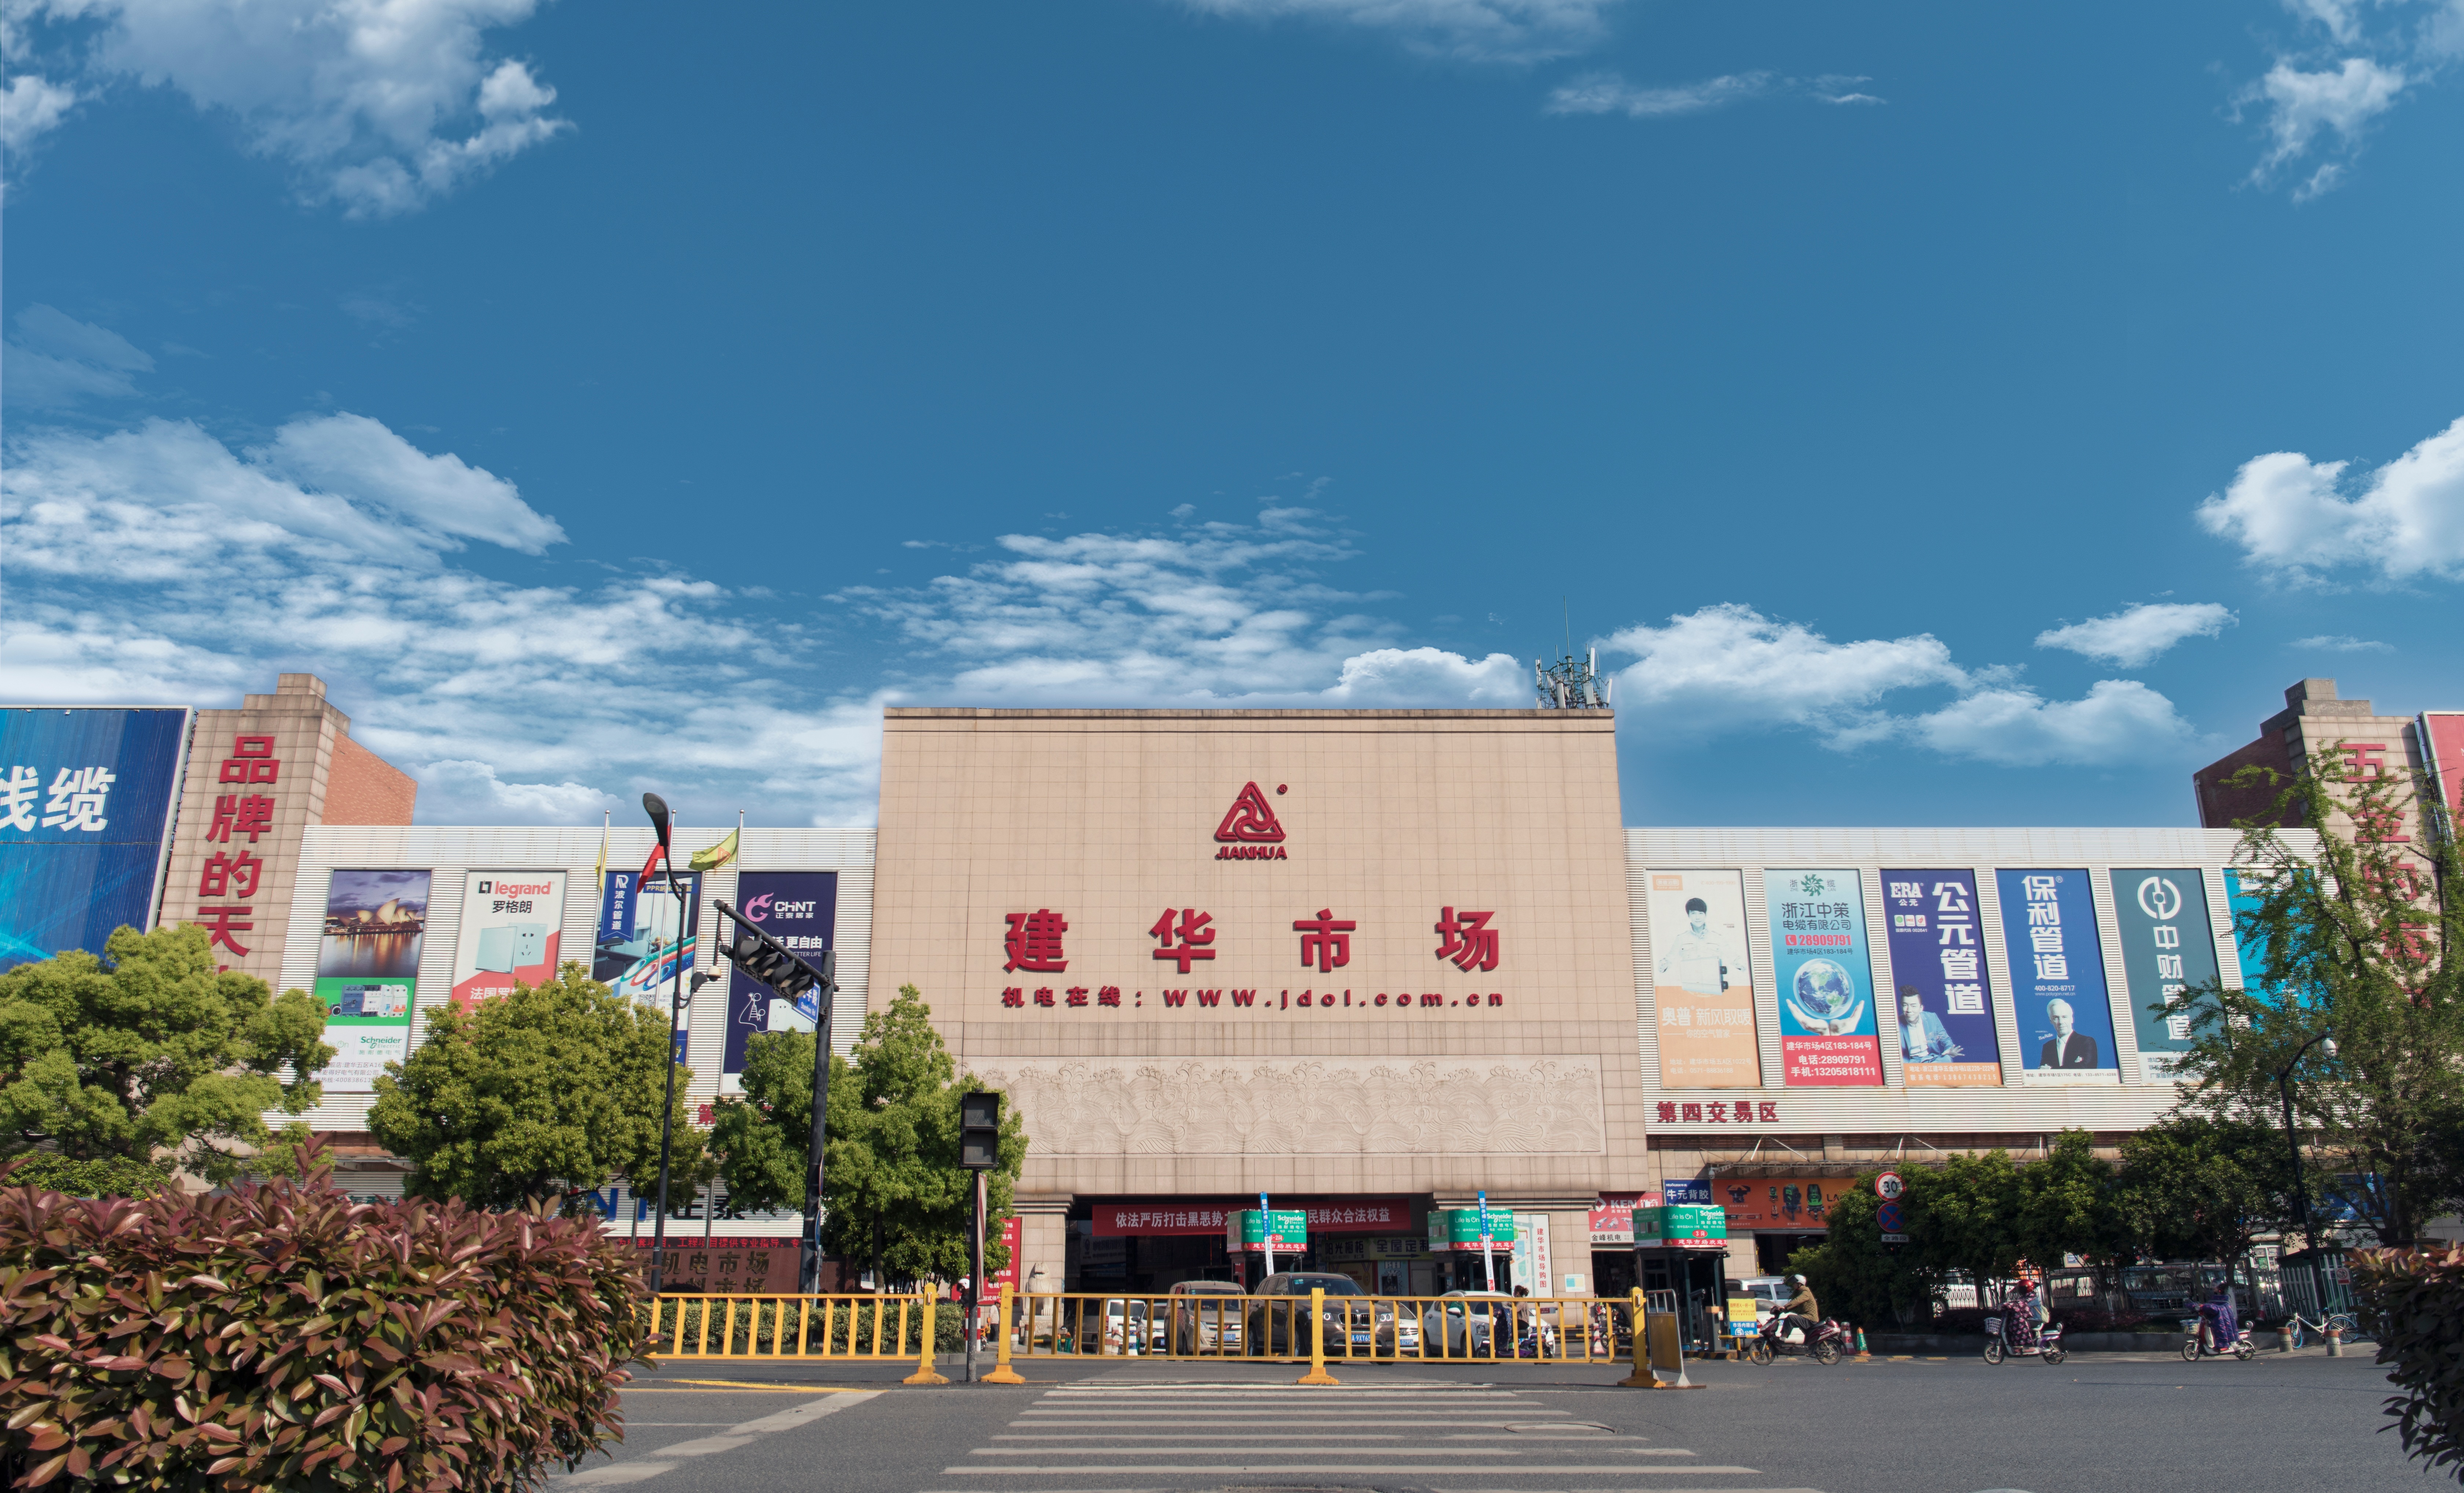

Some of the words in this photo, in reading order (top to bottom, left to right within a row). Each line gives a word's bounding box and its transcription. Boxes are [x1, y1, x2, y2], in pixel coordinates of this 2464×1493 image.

[194, 736, 280, 975] 品牌的天
[1216, 846, 1288, 859] JIANHUA
[495, 881, 550, 899] legrand
[1890, 883, 1923, 898] ERA
[492, 900, 532, 914] 罗格朗
[612, 891, 625, 930] 波尔管道
[1782, 902, 1849, 918] 浙江中策
[1783, 919, 1851, 930] 电缆有限公司
[2021, 876, 2069, 980] 保利管道
[1004, 906, 1499, 973] 建华市场
[1799, 935, 1851, 946] 28909791
[1932, 883, 1985, 1014] 公元管道
[2153, 925, 2192, 1040] 中财管道
[1662, 1007, 1691, 1026] 奥普
[1696, 1008, 1752, 1026] 新风取暖
[1686, 1029, 1730, 1038] 你的空气管家
[1786, 1041, 1871, 1050] 建华市场4区183-184号
[1798, 1055, 1866, 1065] 电话:28909791
[1791, 1067, 1875, 1077] 手机:13205818111
[1657, 1101, 1780, 1123] 第四交易区
[1883, 1181, 1898, 1193] 30
[1666, 1189, 1709, 1200] 牛元背胶
[1610, 1200, 1637, 1209] KEN
[1326, 1241, 1364, 1254] 阳光橱柜
[1377, 1239, 1429, 1252] 全屋定制
[1537, 1228, 1547, 1287] 建华市场导购图
